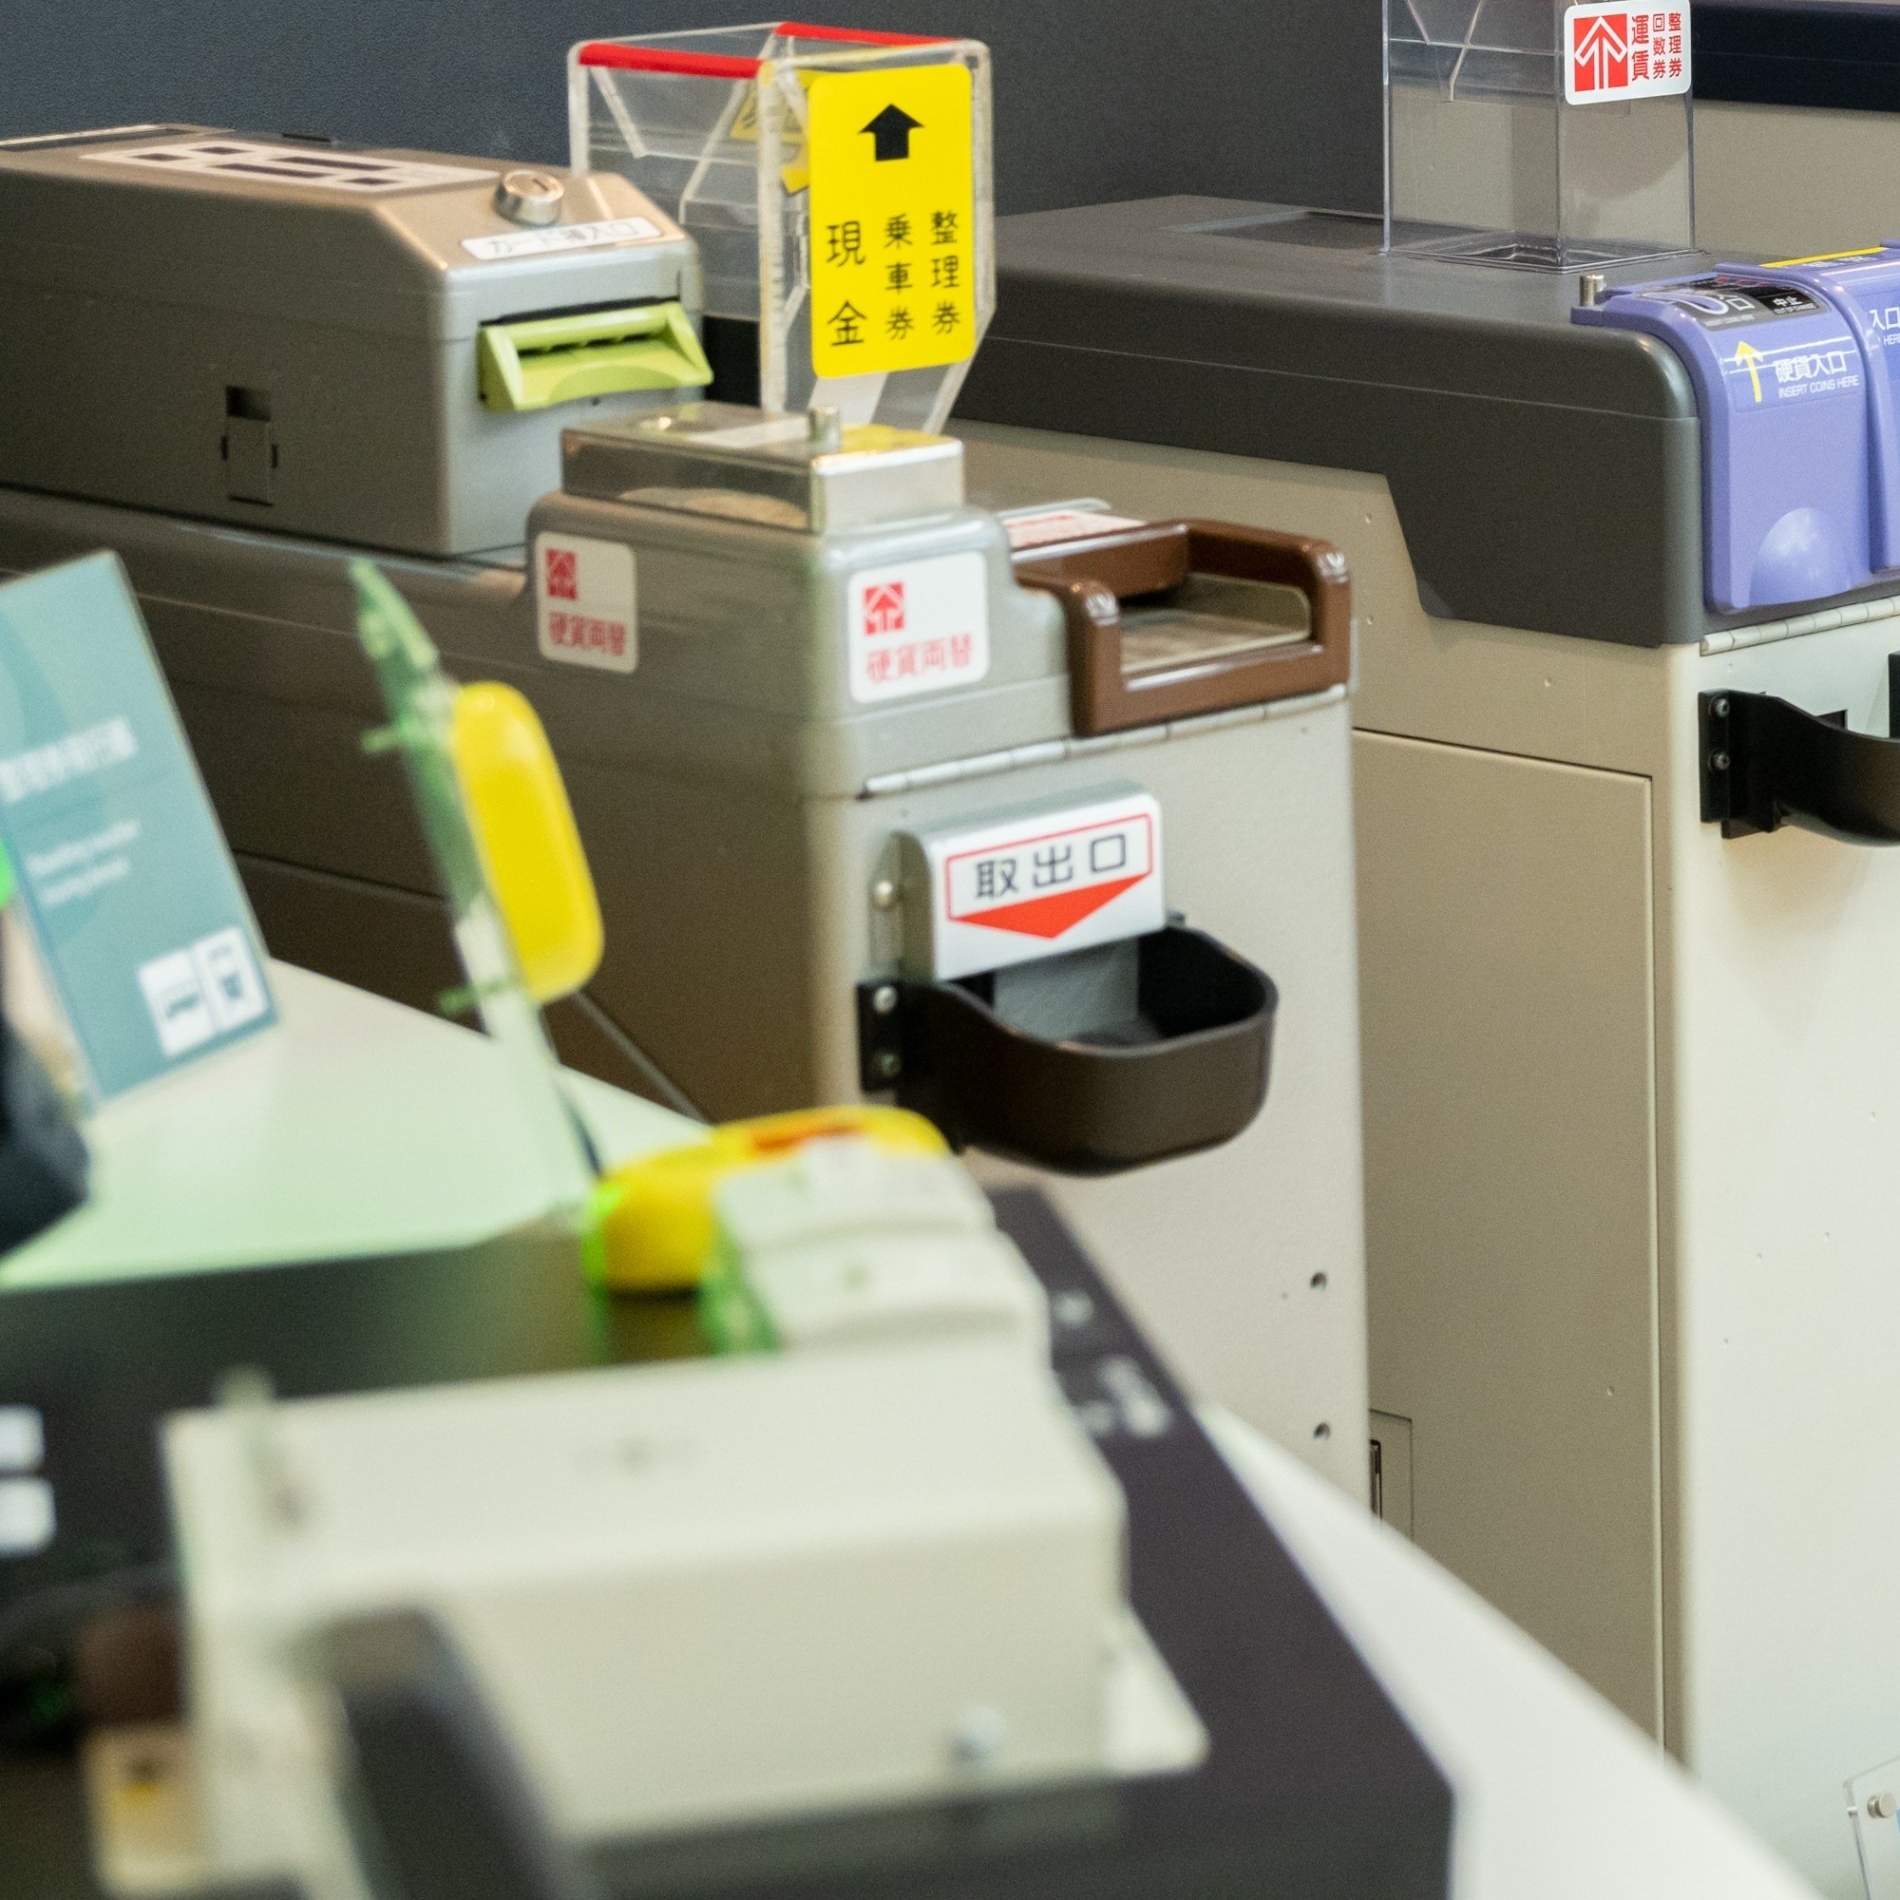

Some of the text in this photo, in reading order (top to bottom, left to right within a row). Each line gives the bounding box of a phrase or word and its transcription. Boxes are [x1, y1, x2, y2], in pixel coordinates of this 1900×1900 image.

[1631, 14, 1650, 82] 運賃
[1653, 13, 1666, 80] 回数券
[1668, 11, 1682, 78] 整理券
[825, 220, 868, 347] 現金
[884, 213, 915, 341] 乗車券
[930, 210, 961, 336] 整理券
[1774, 351, 1848, 383] 硬貨入口
[1778, 374, 1861, 398] INSERT COINS HERE
[547, 611, 628, 659] 硬貨両替
[865, 633, 974, 684] 硬貨両替
[975, 833, 1127, 900] 取出口
